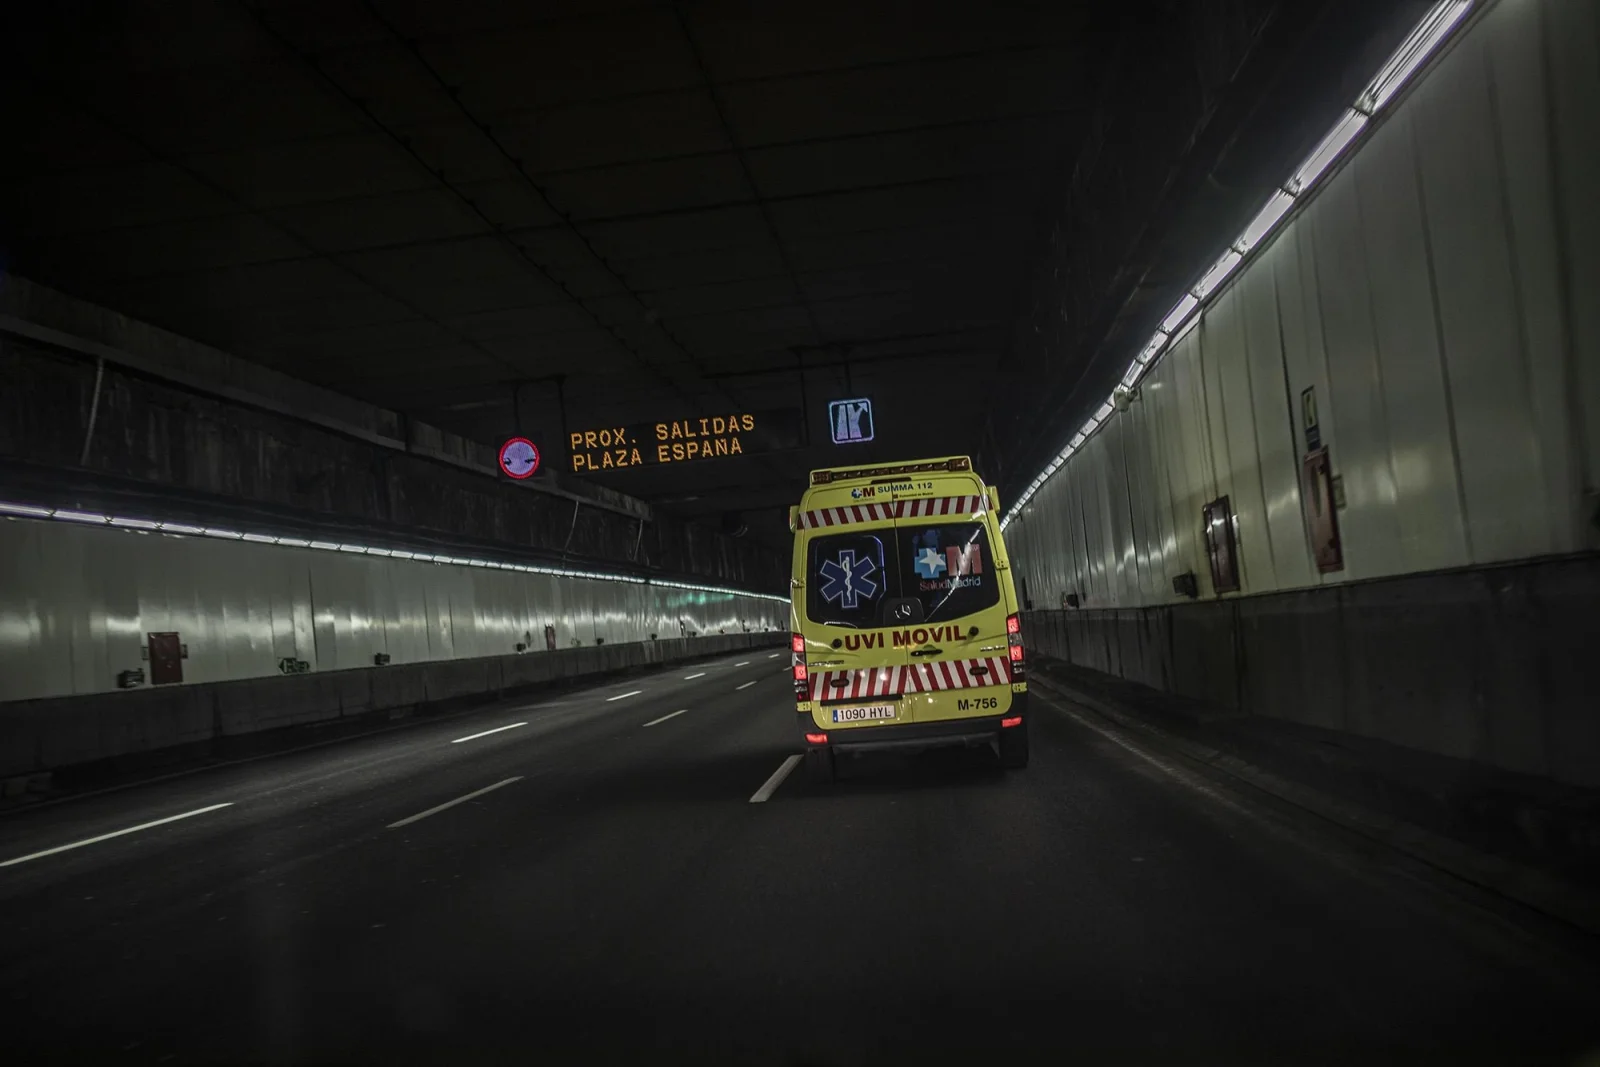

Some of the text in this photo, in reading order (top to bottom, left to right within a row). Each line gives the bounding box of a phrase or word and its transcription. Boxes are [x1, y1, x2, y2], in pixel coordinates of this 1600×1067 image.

[571, 414, 755, 450] PROX. SALIDAS
[572, 448, 643, 472] PLAZA
[862, 482, 933, 497] M SUMMA 112
[844, 625, 967, 650] UVI MOVIL
[840, 706, 891, 720] 1090 HYL
[958, 697, 998, 711] M-756
